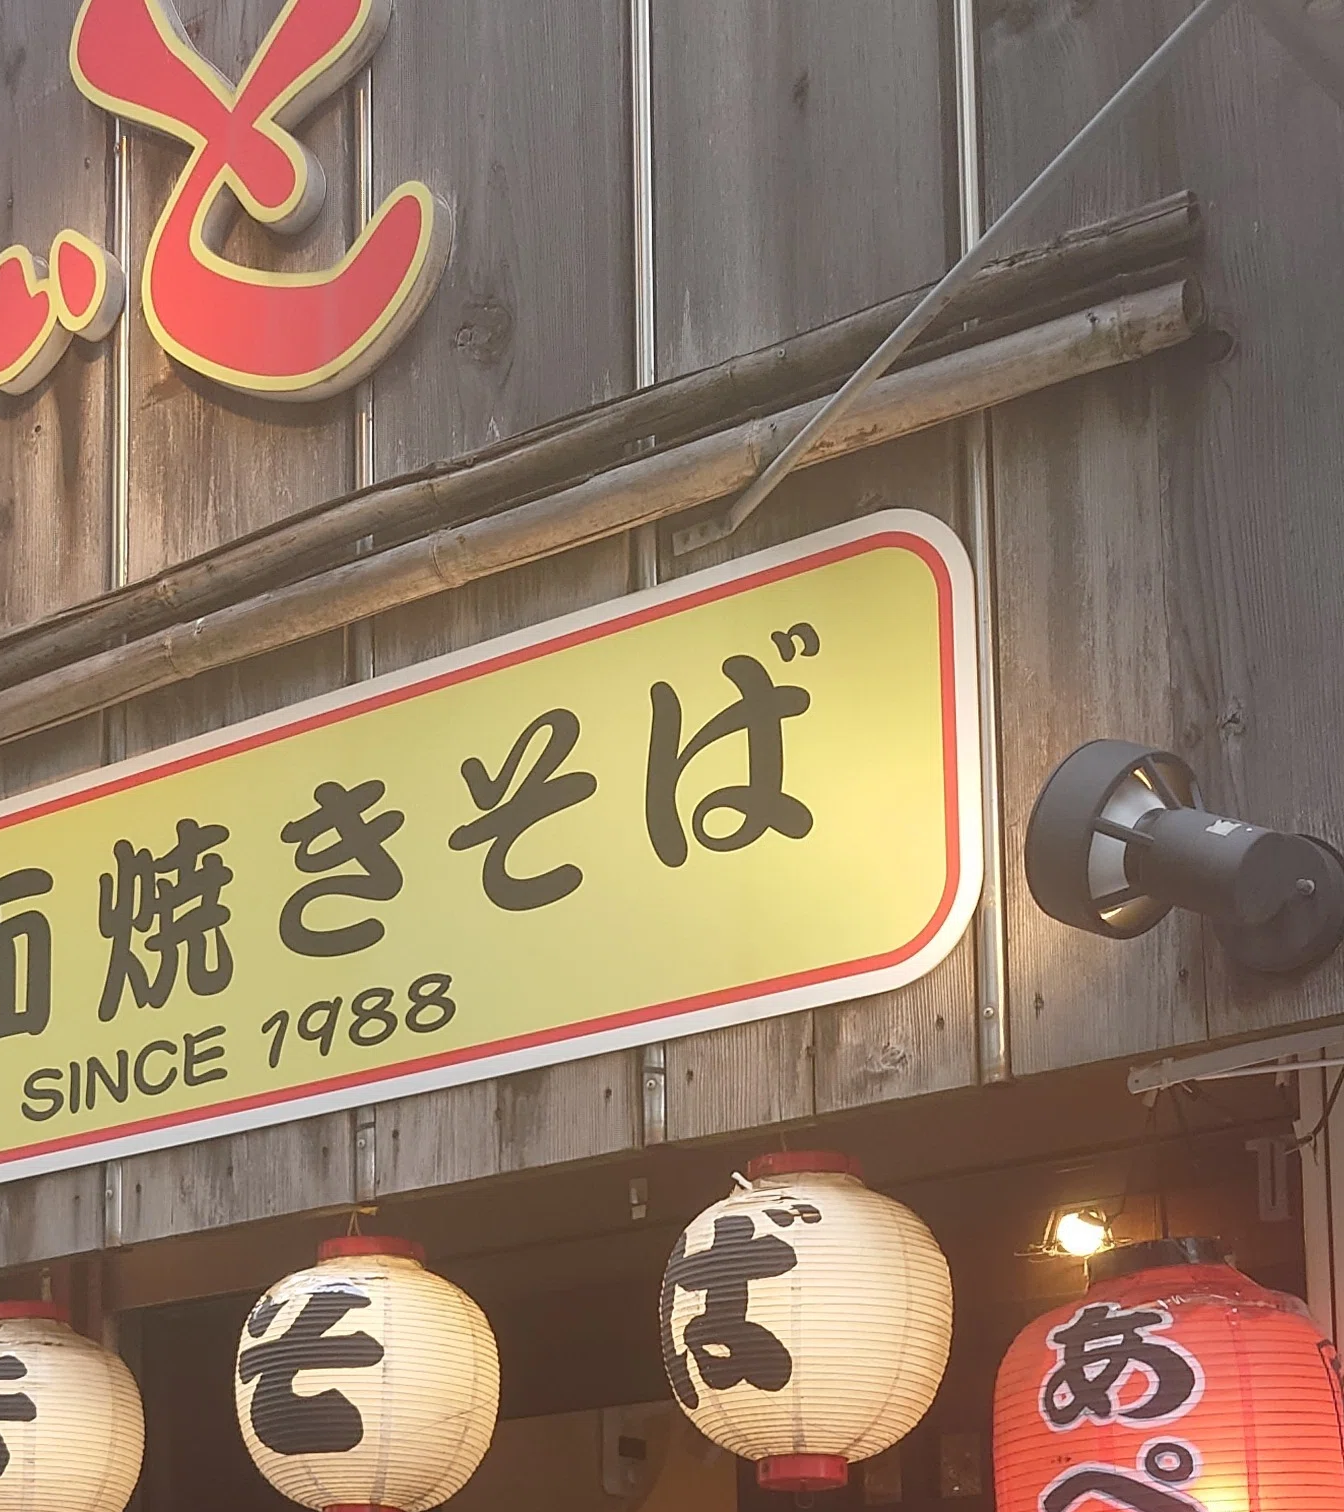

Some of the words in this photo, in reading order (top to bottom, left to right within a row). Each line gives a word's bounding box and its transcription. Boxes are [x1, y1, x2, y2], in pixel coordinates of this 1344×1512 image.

[20, 1026, 229, 1123] SINCE
[261, 973, 456, 1071] 1988
[240, 1291, 384, 1455] そ
[661, 1203, 823, 1409] ば
